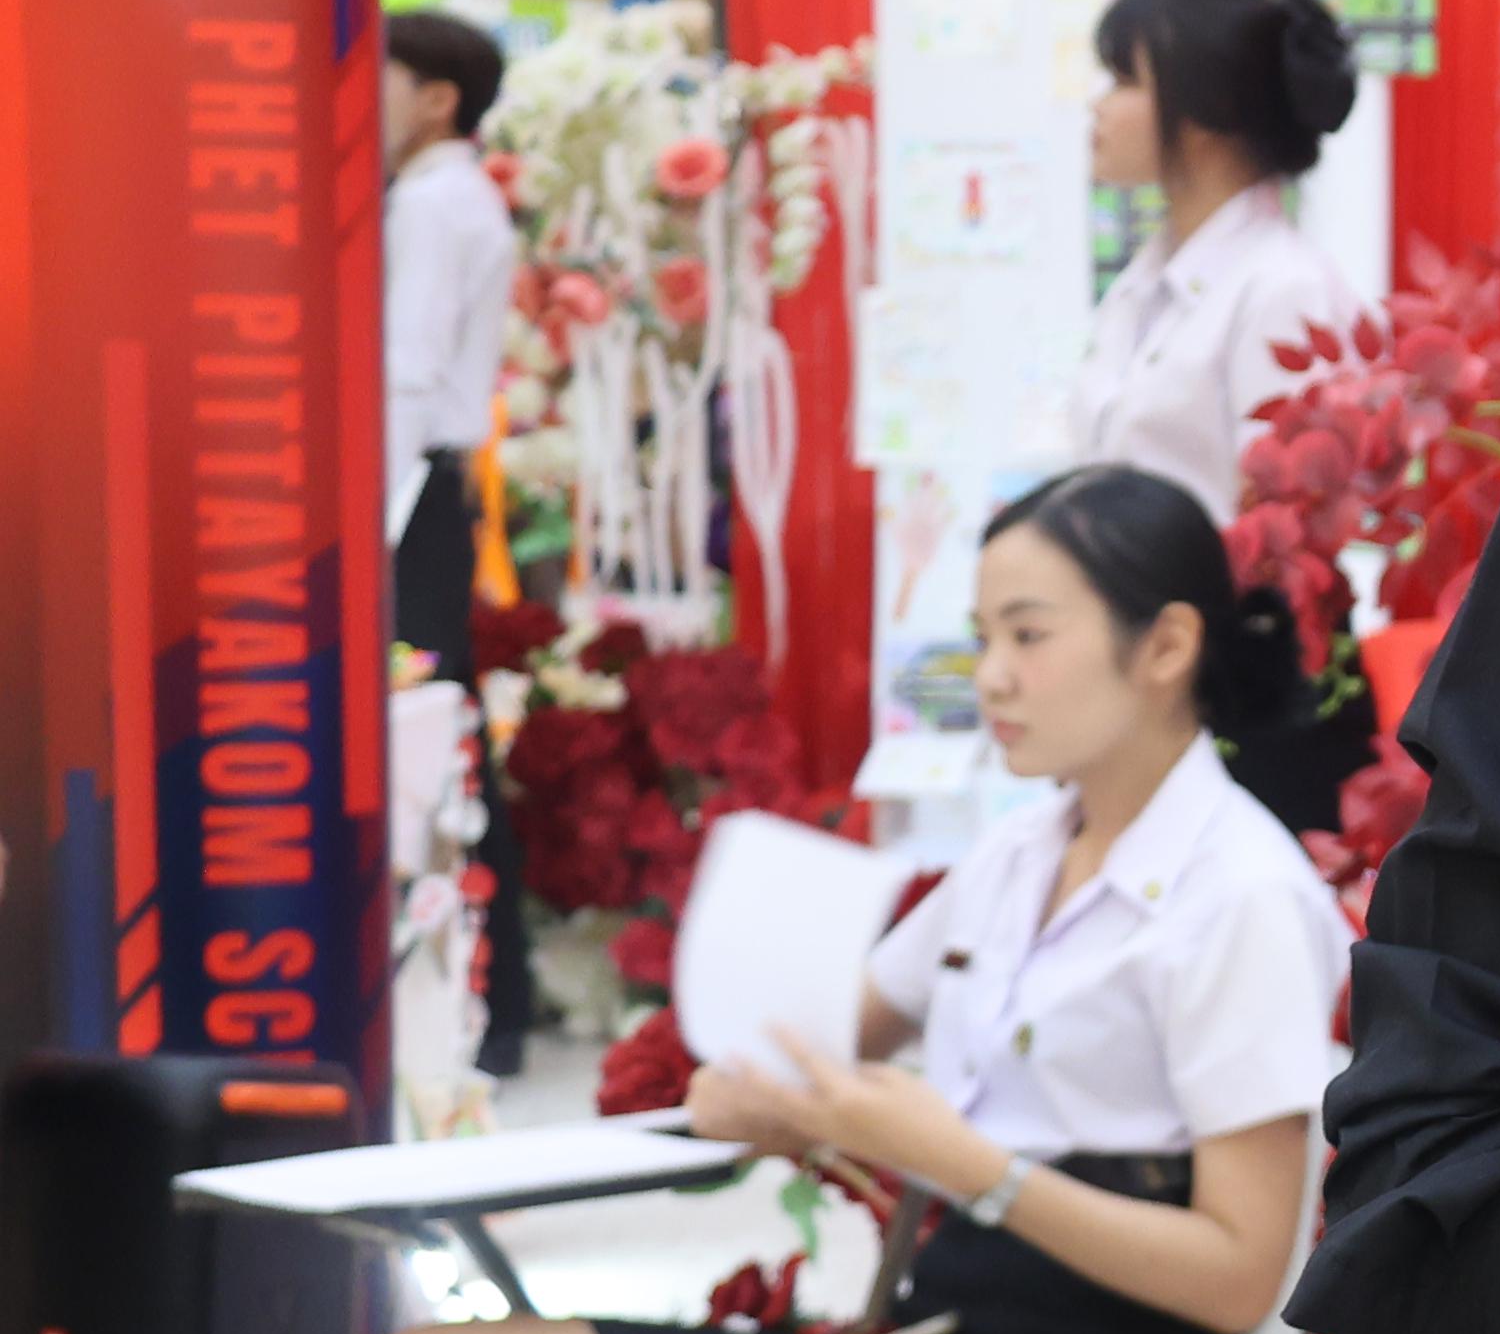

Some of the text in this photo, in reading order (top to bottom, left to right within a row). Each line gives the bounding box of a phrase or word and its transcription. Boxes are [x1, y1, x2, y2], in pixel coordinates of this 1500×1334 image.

[184, 16, 302, 249] PHET
[190, 290, 314, 890] PITTAYAKOM
[202, 925, 318, 1069] SC
